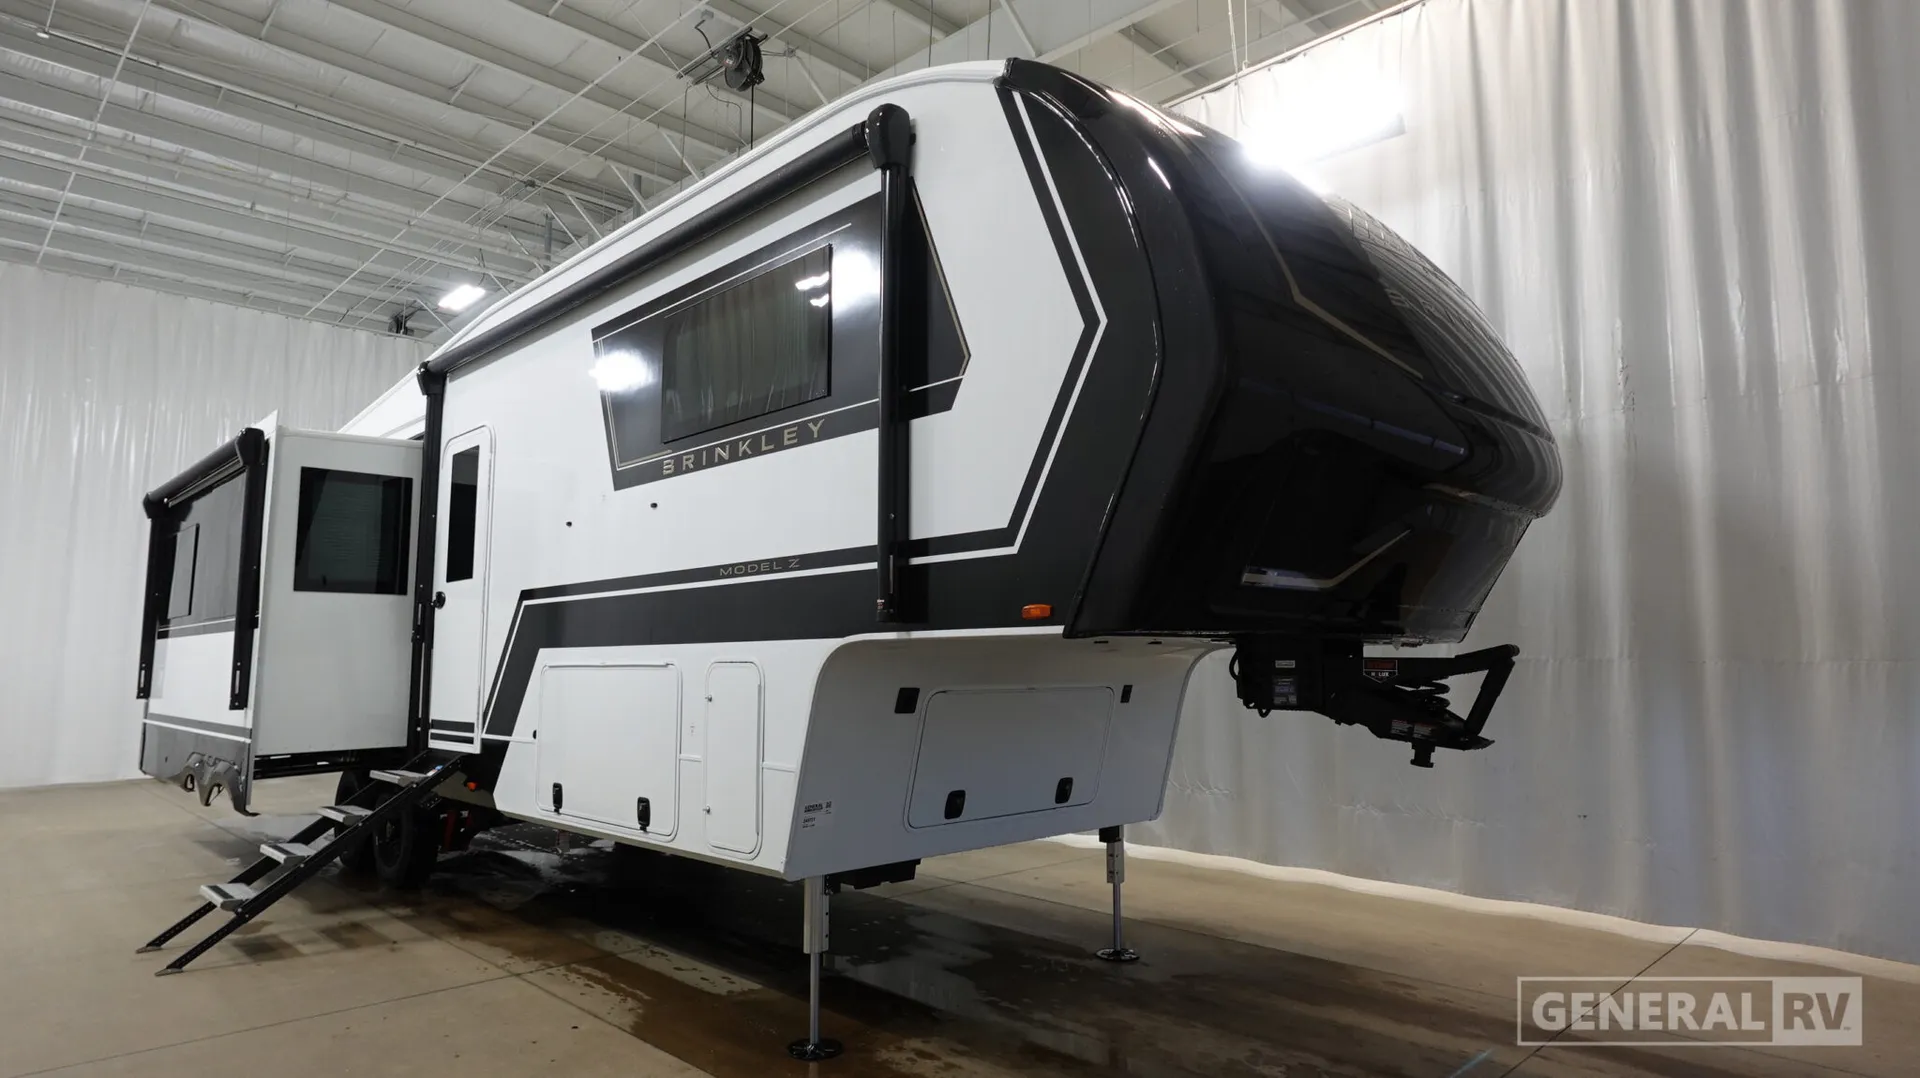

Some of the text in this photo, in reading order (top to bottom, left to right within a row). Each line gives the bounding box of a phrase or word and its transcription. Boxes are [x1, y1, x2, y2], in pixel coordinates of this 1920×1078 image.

[662, 418, 825, 475] BRINKLEY
[719, 558, 800, 576] MODEL Z
